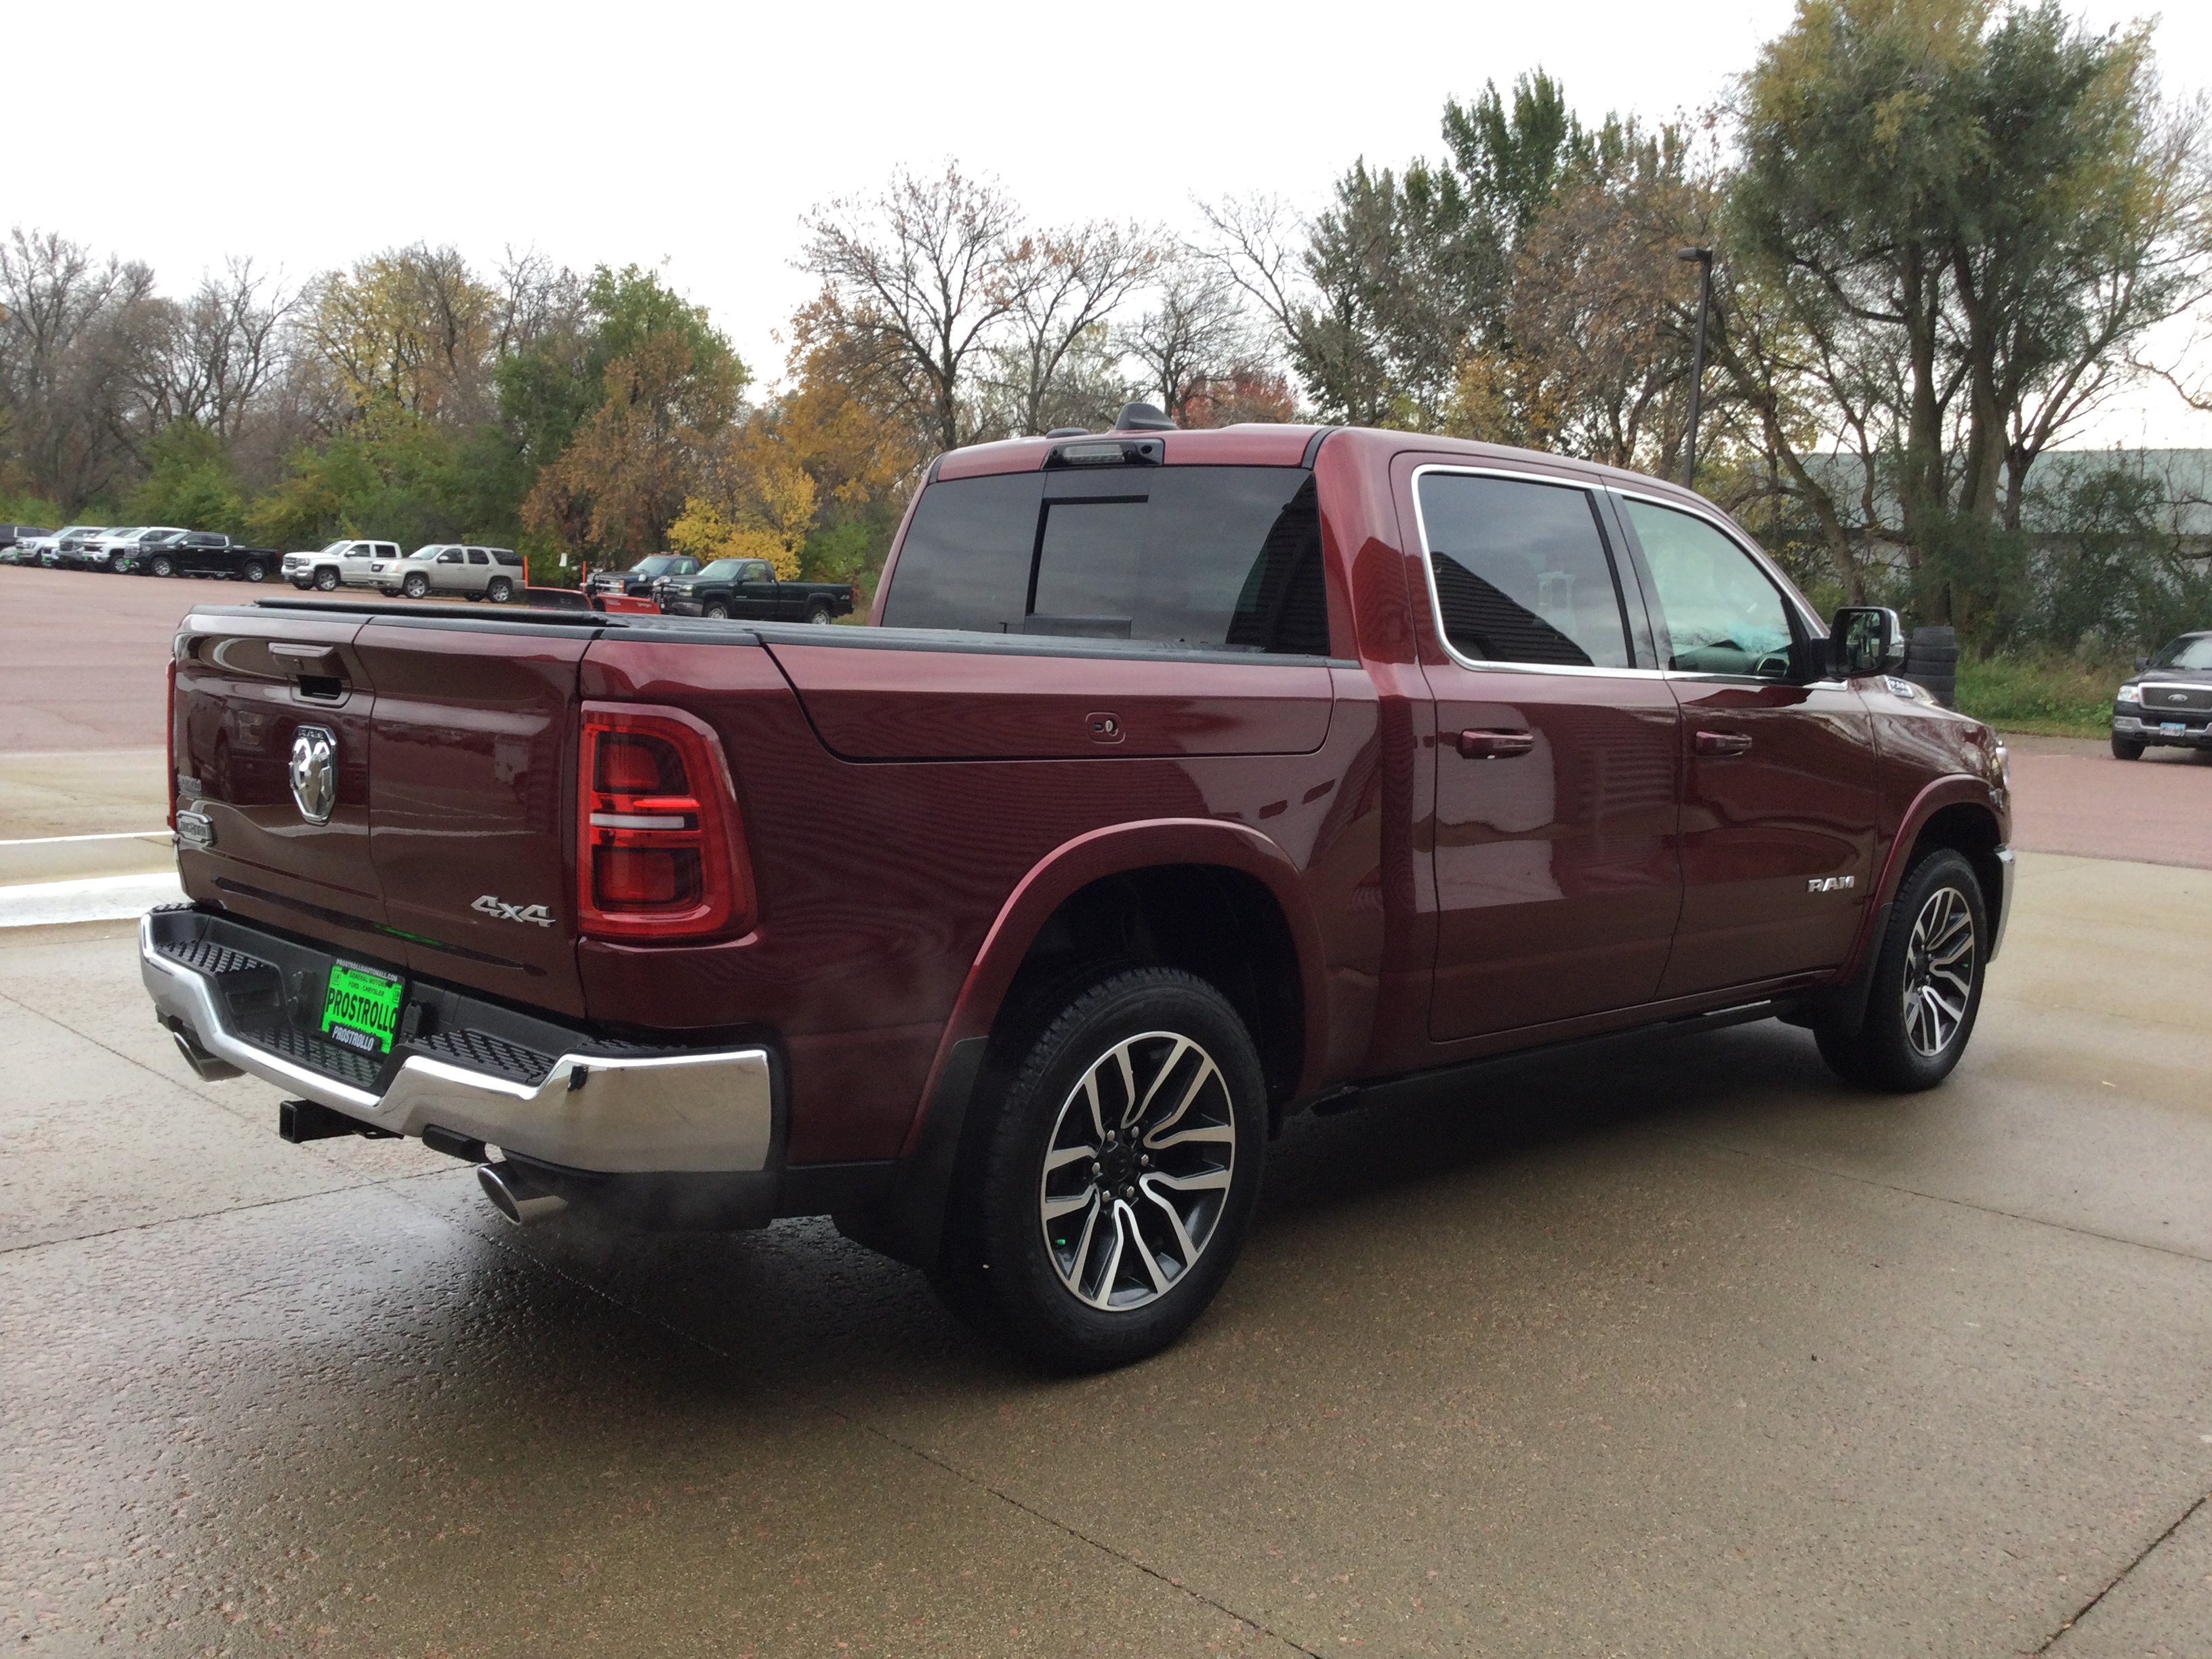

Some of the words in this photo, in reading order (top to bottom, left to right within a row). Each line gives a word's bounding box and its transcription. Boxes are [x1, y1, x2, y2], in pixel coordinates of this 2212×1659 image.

[1807, 876, 1855, 893] RAM
[470, 895, 556, 927] 4x4
[325, 987, 398, 1032] PROSTROLLO
[331, 1025, 375, 1051] PROSTROLLO
